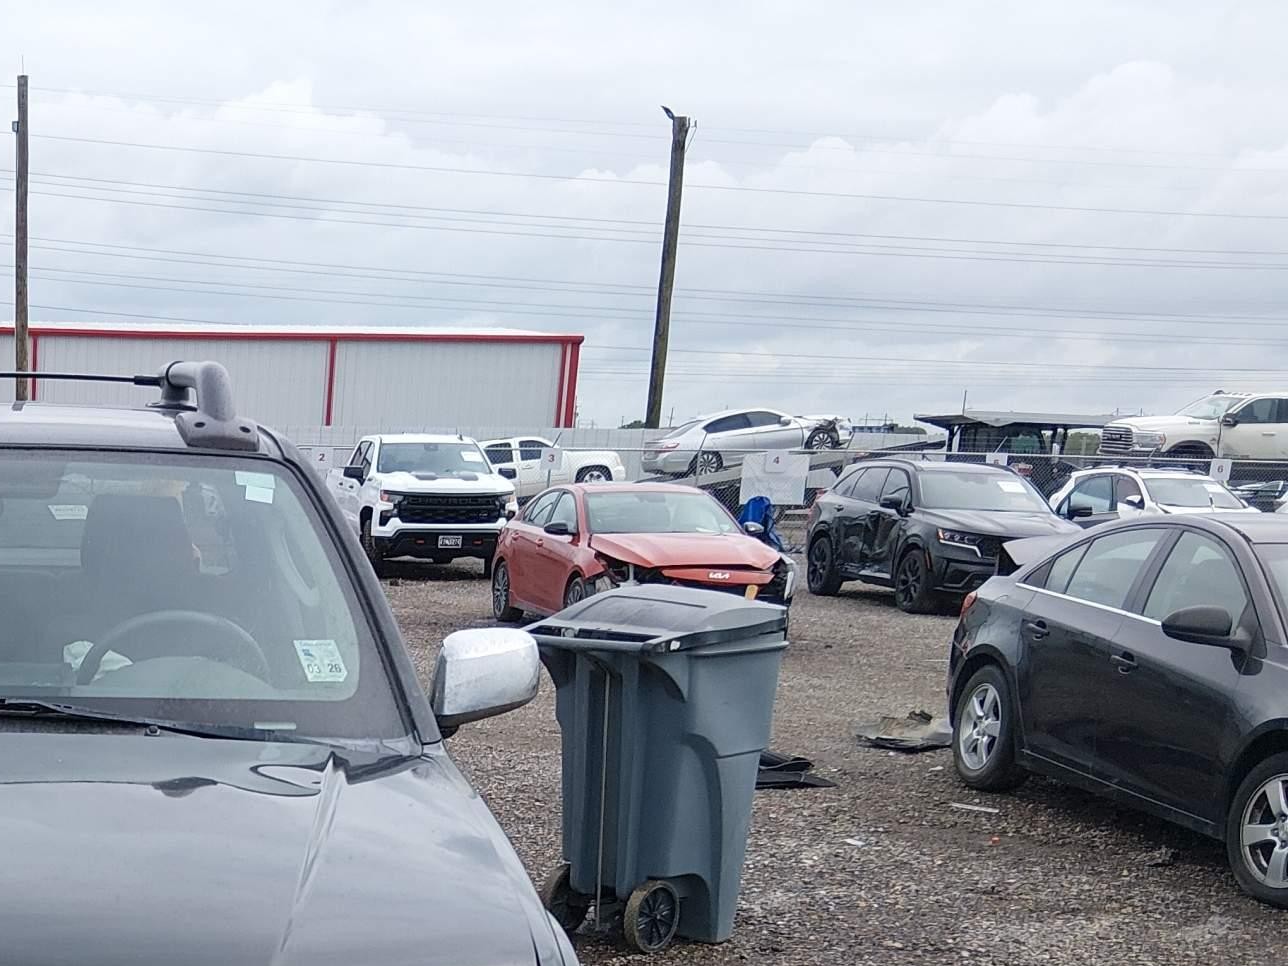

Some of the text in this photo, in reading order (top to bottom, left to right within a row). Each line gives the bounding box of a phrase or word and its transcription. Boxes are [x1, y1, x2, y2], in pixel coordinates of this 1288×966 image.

[318, 453, 326, 462] 2
[548, 454, 555, 463] 3
[773, 456, 780, 465] 4
[708, 571, 730, 580] KIA
